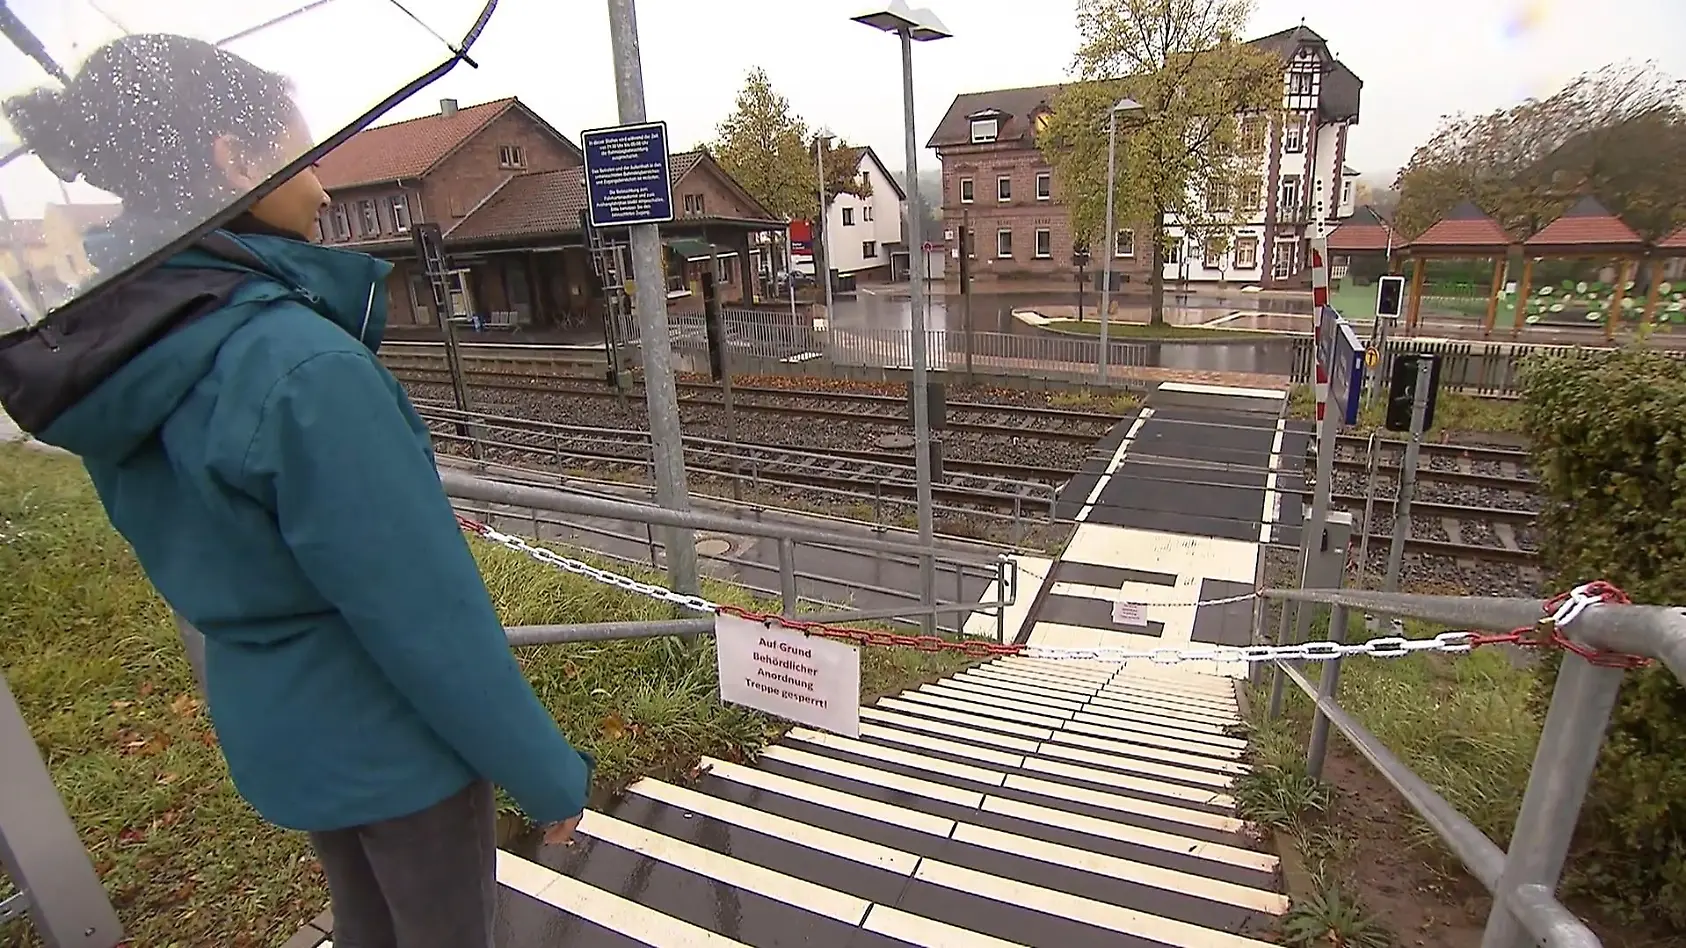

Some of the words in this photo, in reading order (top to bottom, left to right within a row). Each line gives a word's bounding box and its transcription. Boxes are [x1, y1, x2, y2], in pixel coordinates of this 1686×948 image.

[758, 637, 777, 650] Auf
[780, 642, 812, 659] Grund
[752, 651, 818, 677] Behördlicher
[757, 667, 814, 692] Anordnung
[745, 677, 780, 696] Treppe
[781, 688, 828, 710] gesperrt!
